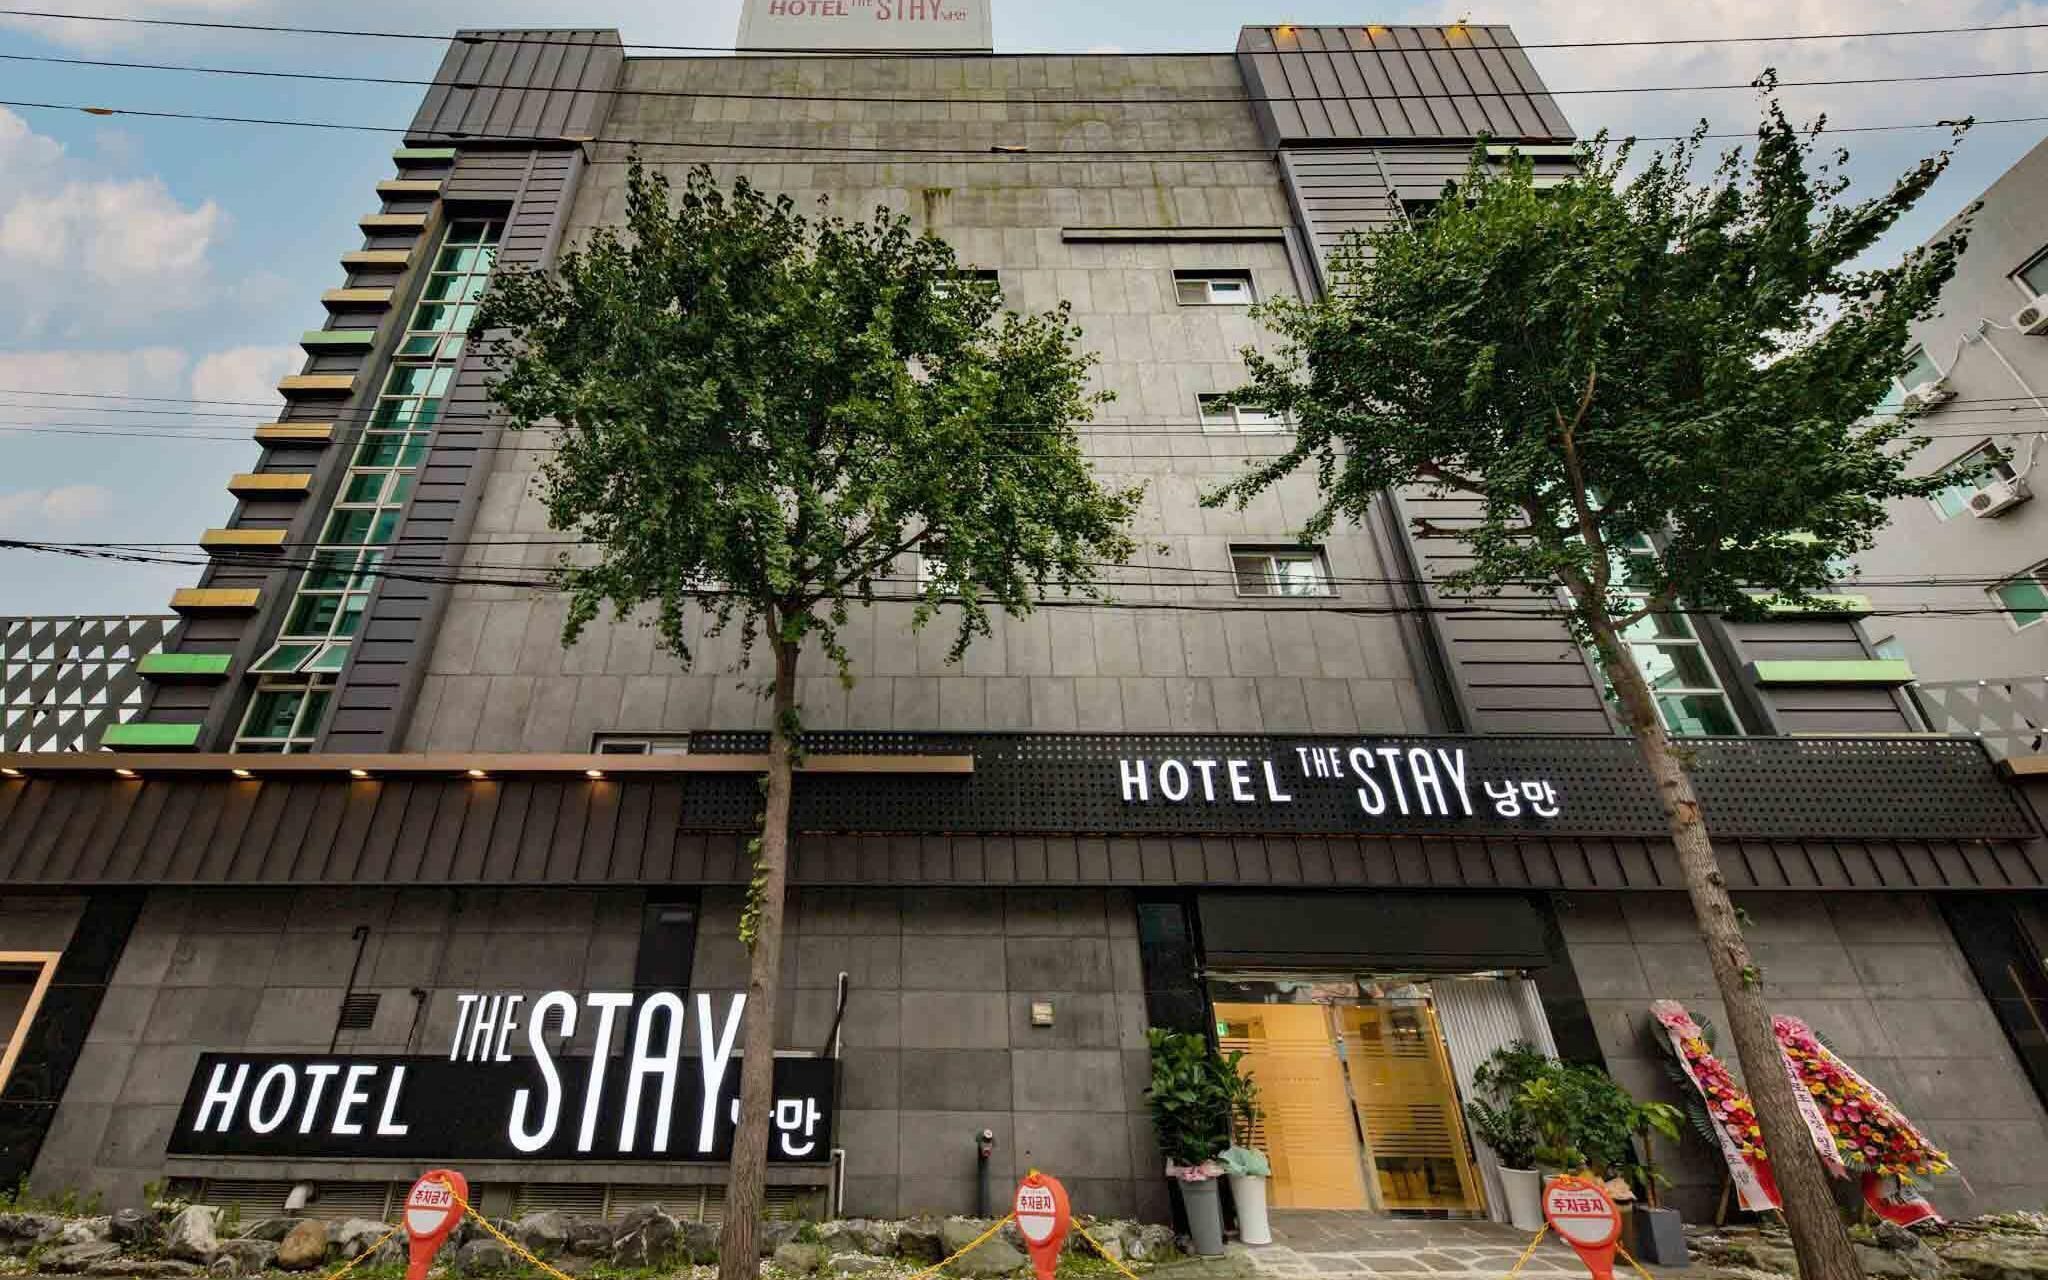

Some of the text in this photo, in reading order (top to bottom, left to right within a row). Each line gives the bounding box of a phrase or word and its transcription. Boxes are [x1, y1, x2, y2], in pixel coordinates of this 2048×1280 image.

[768, 0, 849, 16] HOTEL
[1119, 747, 1560, 817] HOTEL THE STAY 낭만
[193, 990, 821, 1156] HOTEL THE STAY 만
